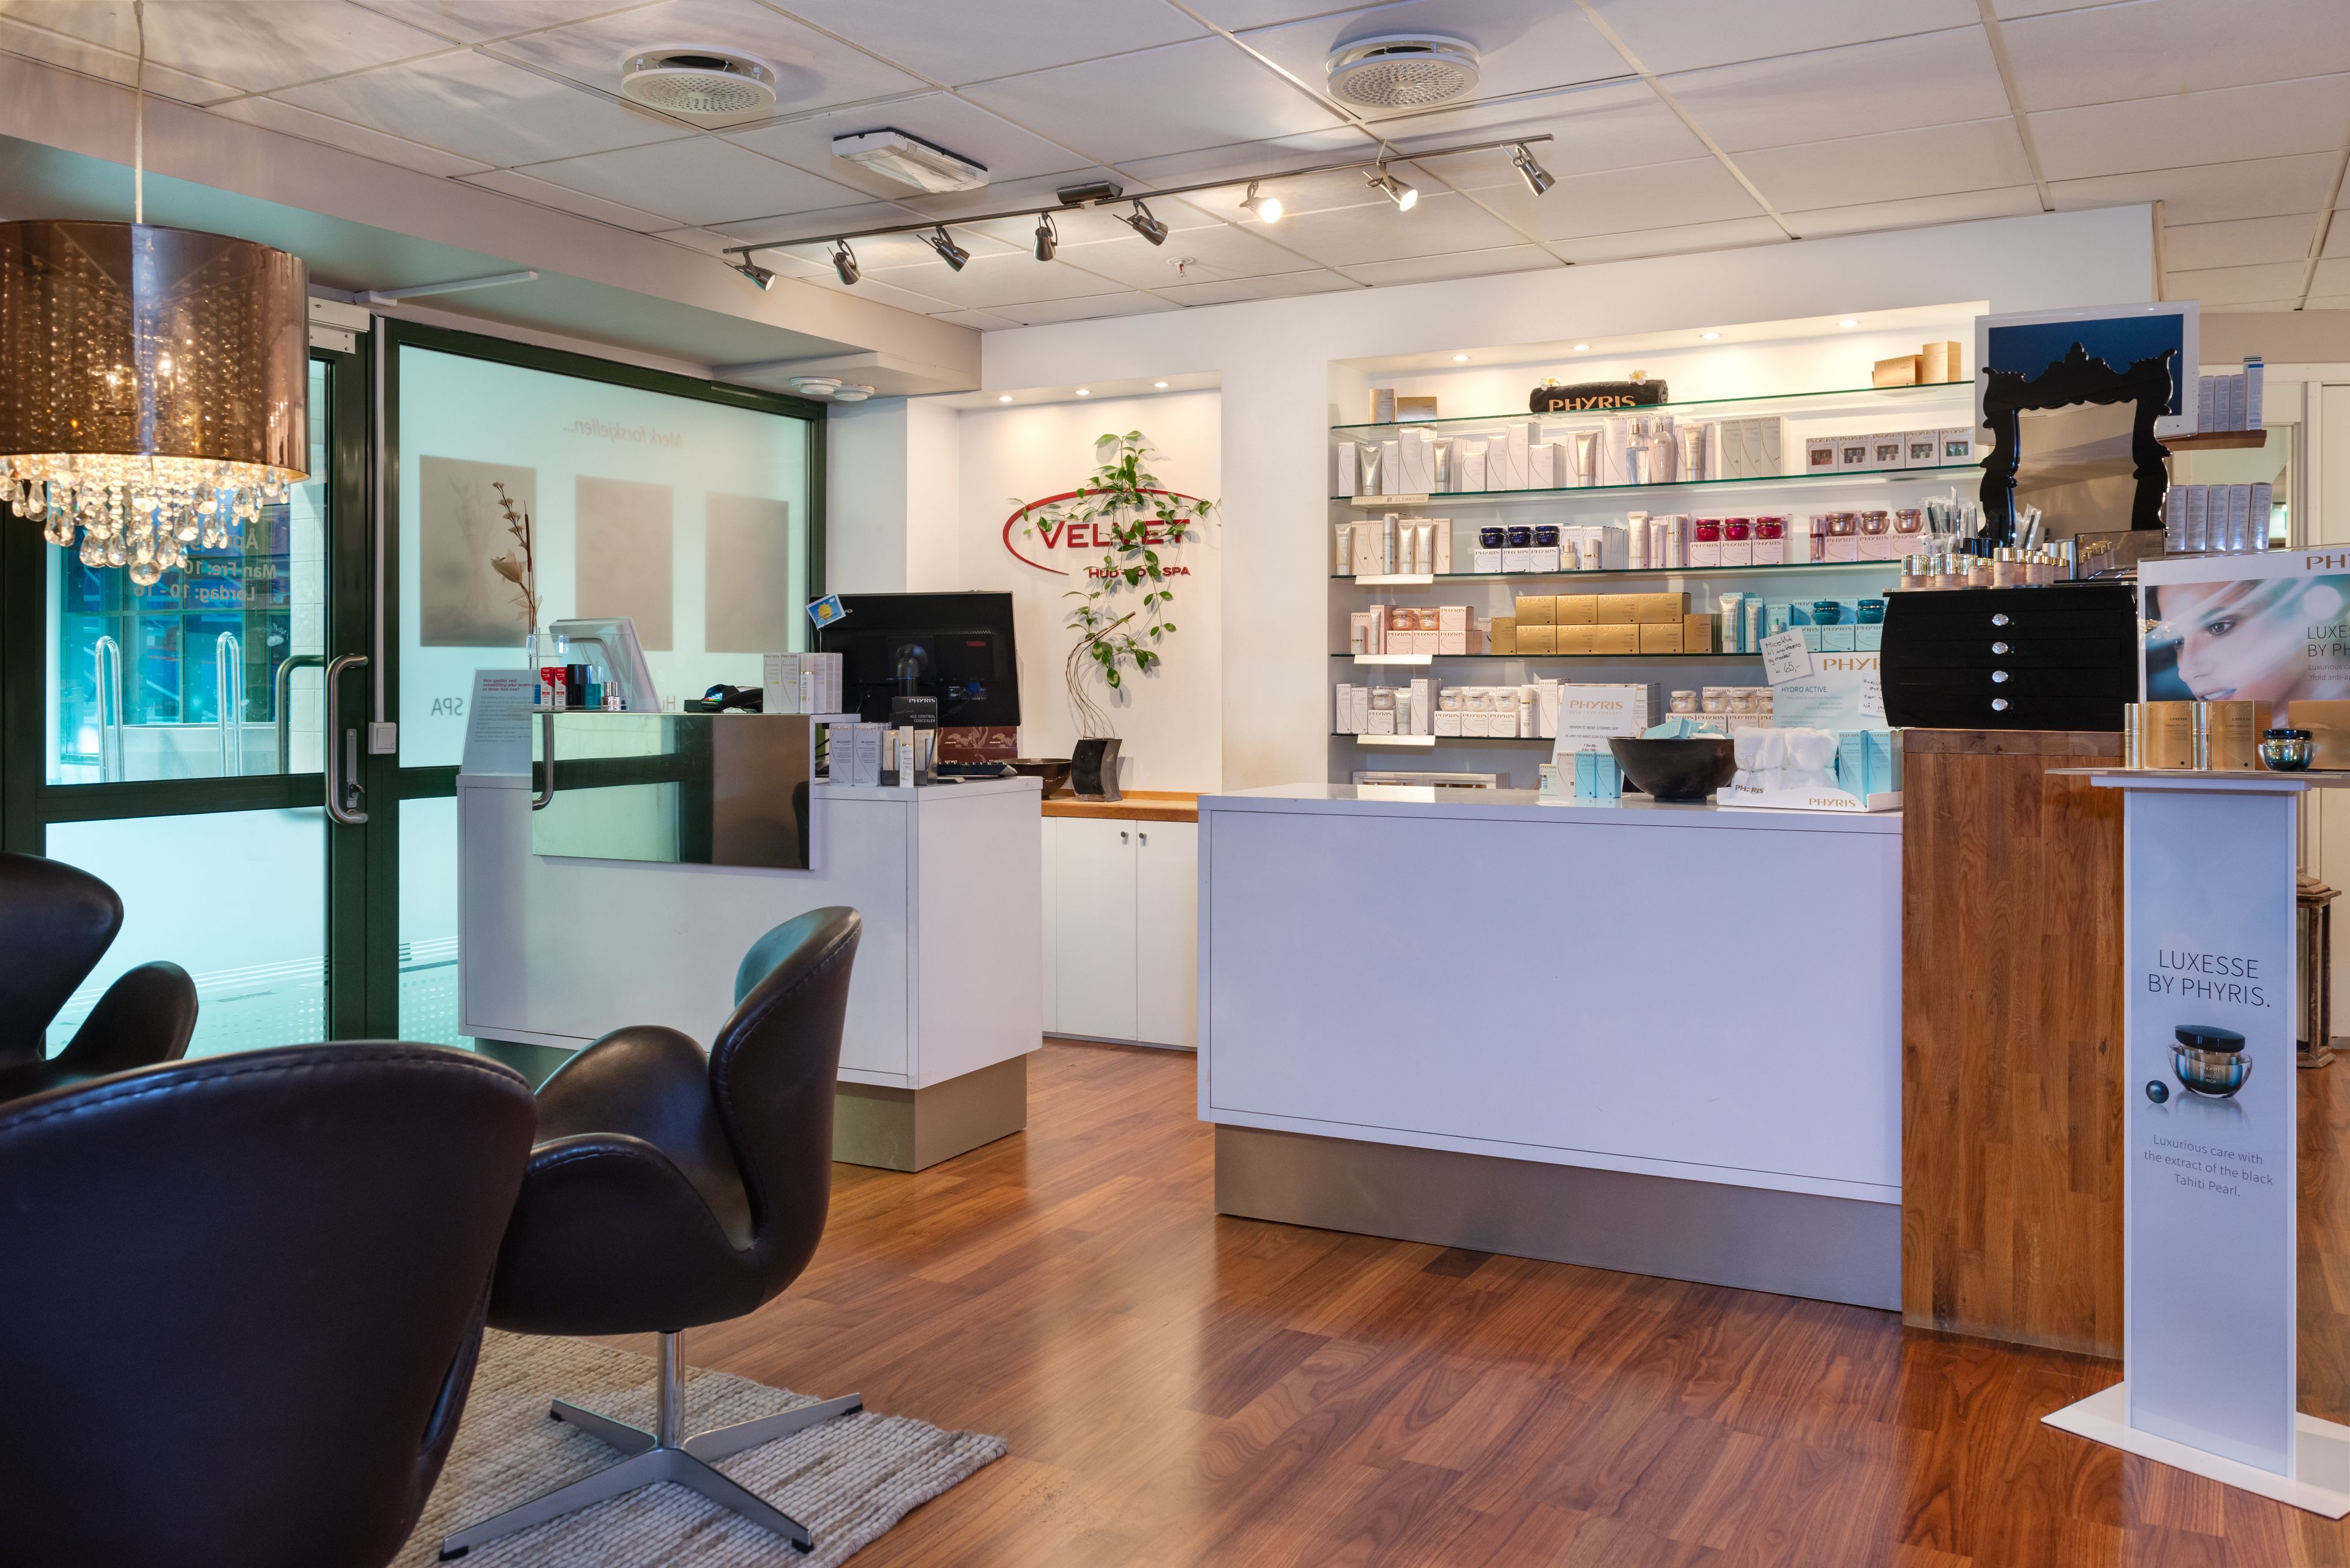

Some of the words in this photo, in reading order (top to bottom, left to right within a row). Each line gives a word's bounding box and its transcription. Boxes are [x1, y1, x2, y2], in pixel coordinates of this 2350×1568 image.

[1548, 395, 1636, 412] PHYRIS
[2306, 554, 2350, 570] PH
[1163, 566, 1191, 577] SPA
[2308, 625, 2350, 639] LUXE
[2308, 644, 2327, 657] BY
[1570, 700, 1624, 710] PHYRIS
[1808, 797, 1856, 807] PHYRIS
[2159, 949, 2259, 979] LUXESSE
[2149, 973, 2174, 994] BY
[2182, 978, 2270, 1007] PHYRIS.
[2154, 1135, 2207, 1154] Luxurious
[2210, 1148, 2234, 1159] care
[2238, 1152, 2263, 1165] with
[2144, 1151, 2162, 1162] the
[2165, 1155, 2203, 1171] extract
[2206, 1163, 2217, 1173] of
[2220, 1165, 2239, 1178] the
[2242, 1169, 2274, 1185] black
[2174, 1173, 2205, 1189] Tahiti
[2209, 1181, 2240, 1197] Pearl.
